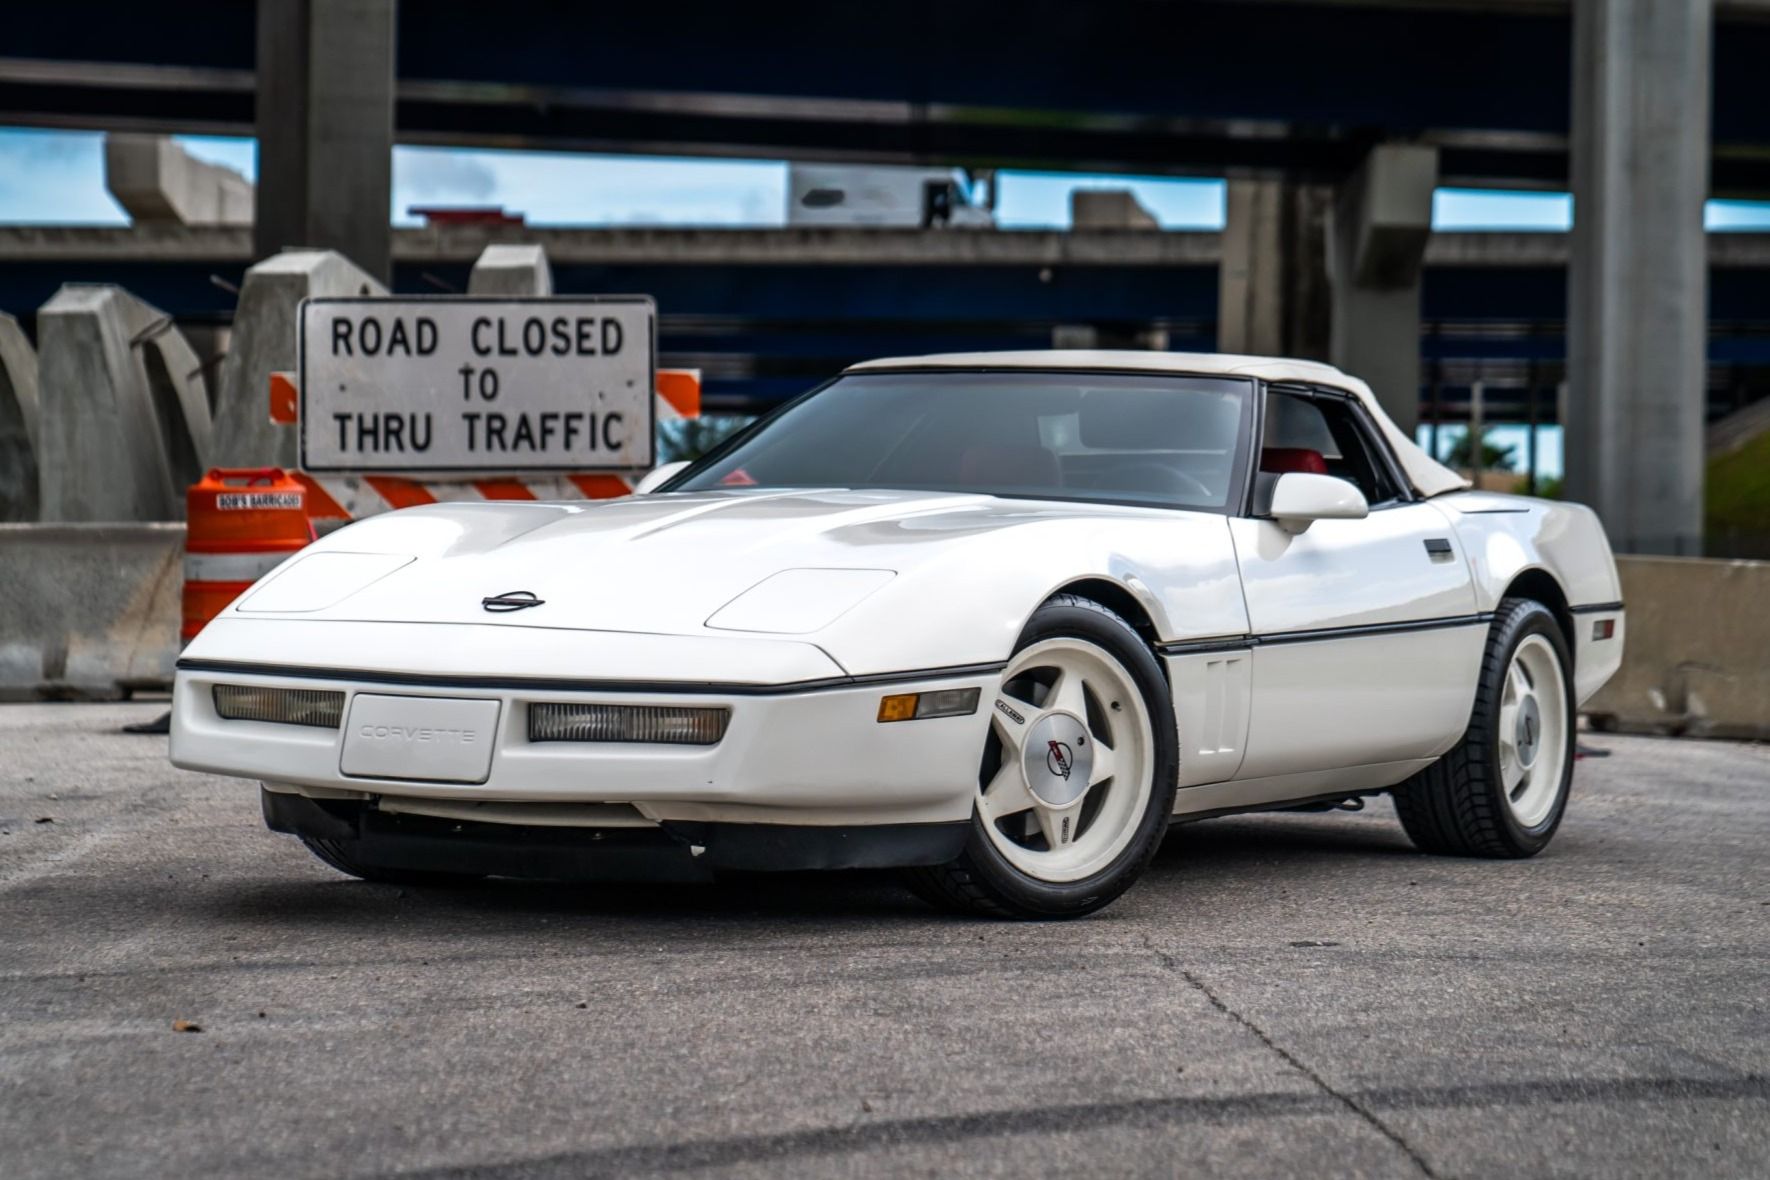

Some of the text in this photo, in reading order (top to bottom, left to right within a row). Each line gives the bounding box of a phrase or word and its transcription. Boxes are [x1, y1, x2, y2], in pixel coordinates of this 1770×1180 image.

[331, 317, 624, 356] ROAD CLOSED
[459, 367, 499, 400] TO
[333, 413, 623, 451] THRU TRAFFIC
[219, 494, 246, 507] BOB'S
[360, 724, 476, 743] CORVETTE
